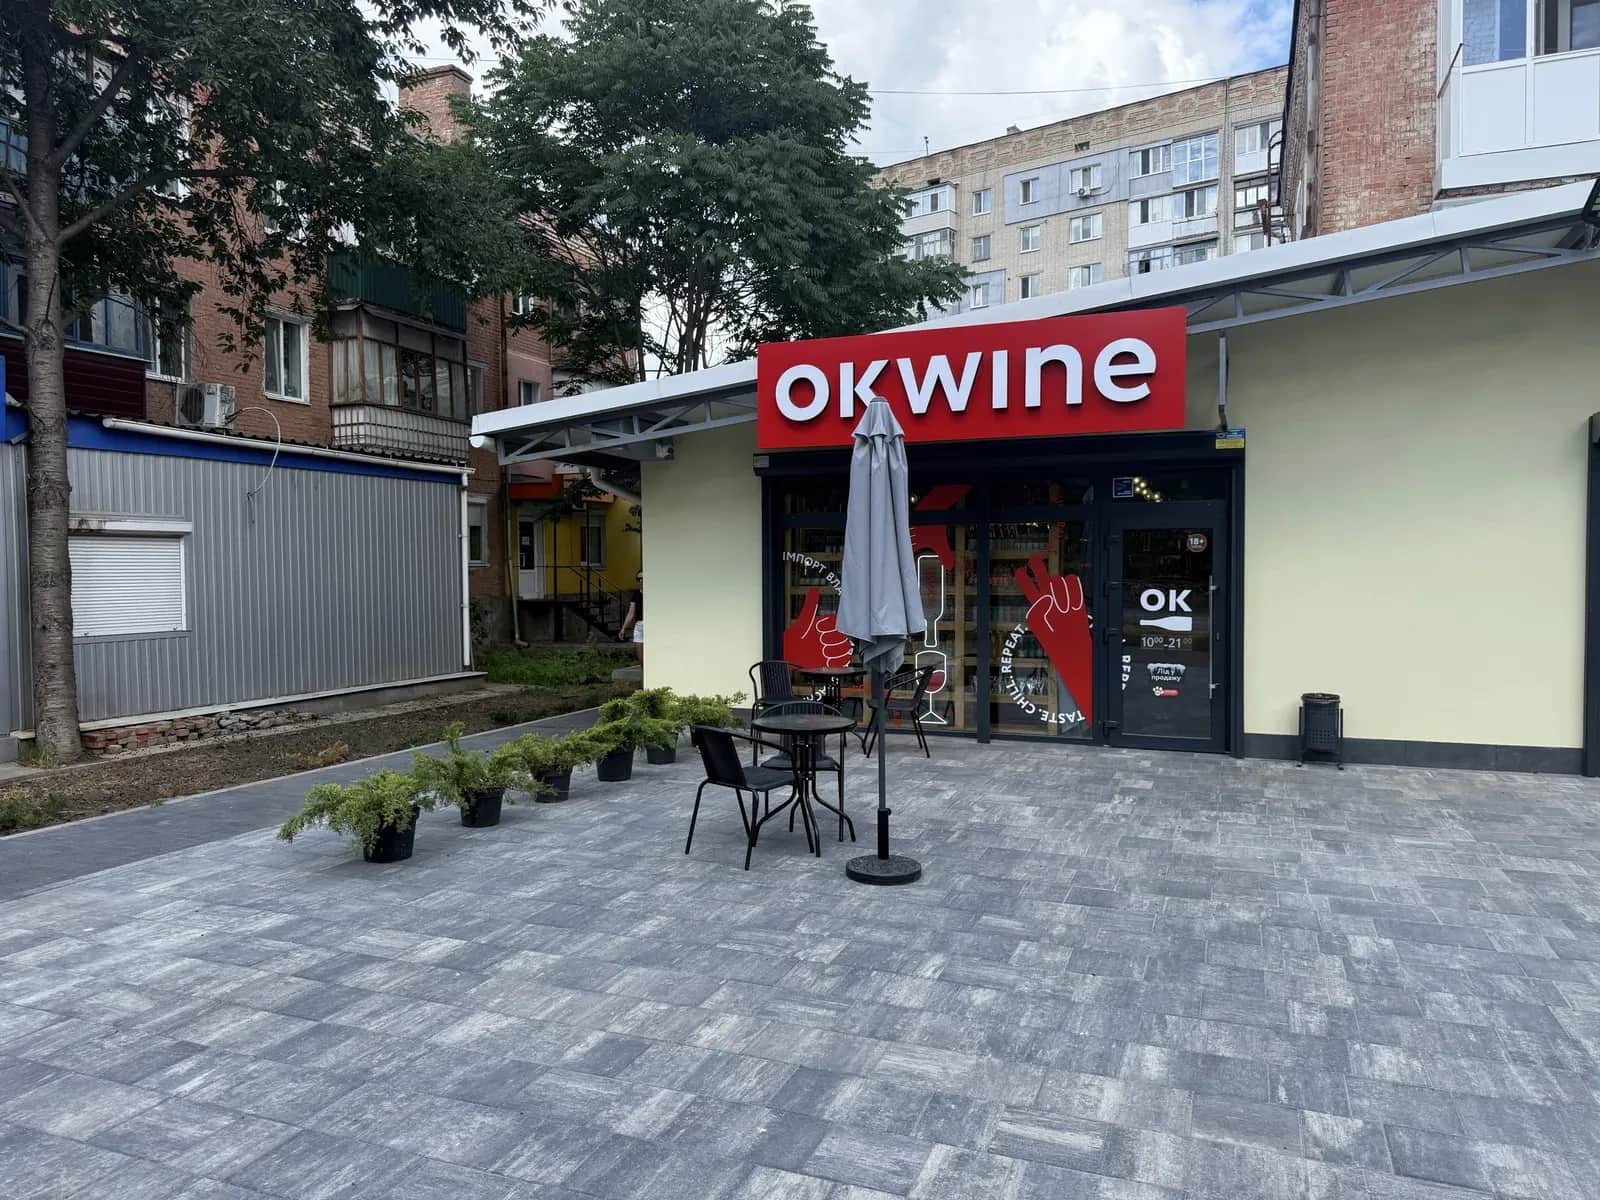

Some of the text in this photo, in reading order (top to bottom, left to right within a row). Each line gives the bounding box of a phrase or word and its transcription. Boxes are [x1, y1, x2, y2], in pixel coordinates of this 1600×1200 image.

[1140, 589, 1193, 612] OK
[1001, 623, 1086, 724] TASTE. CHILL. REPEAT.
